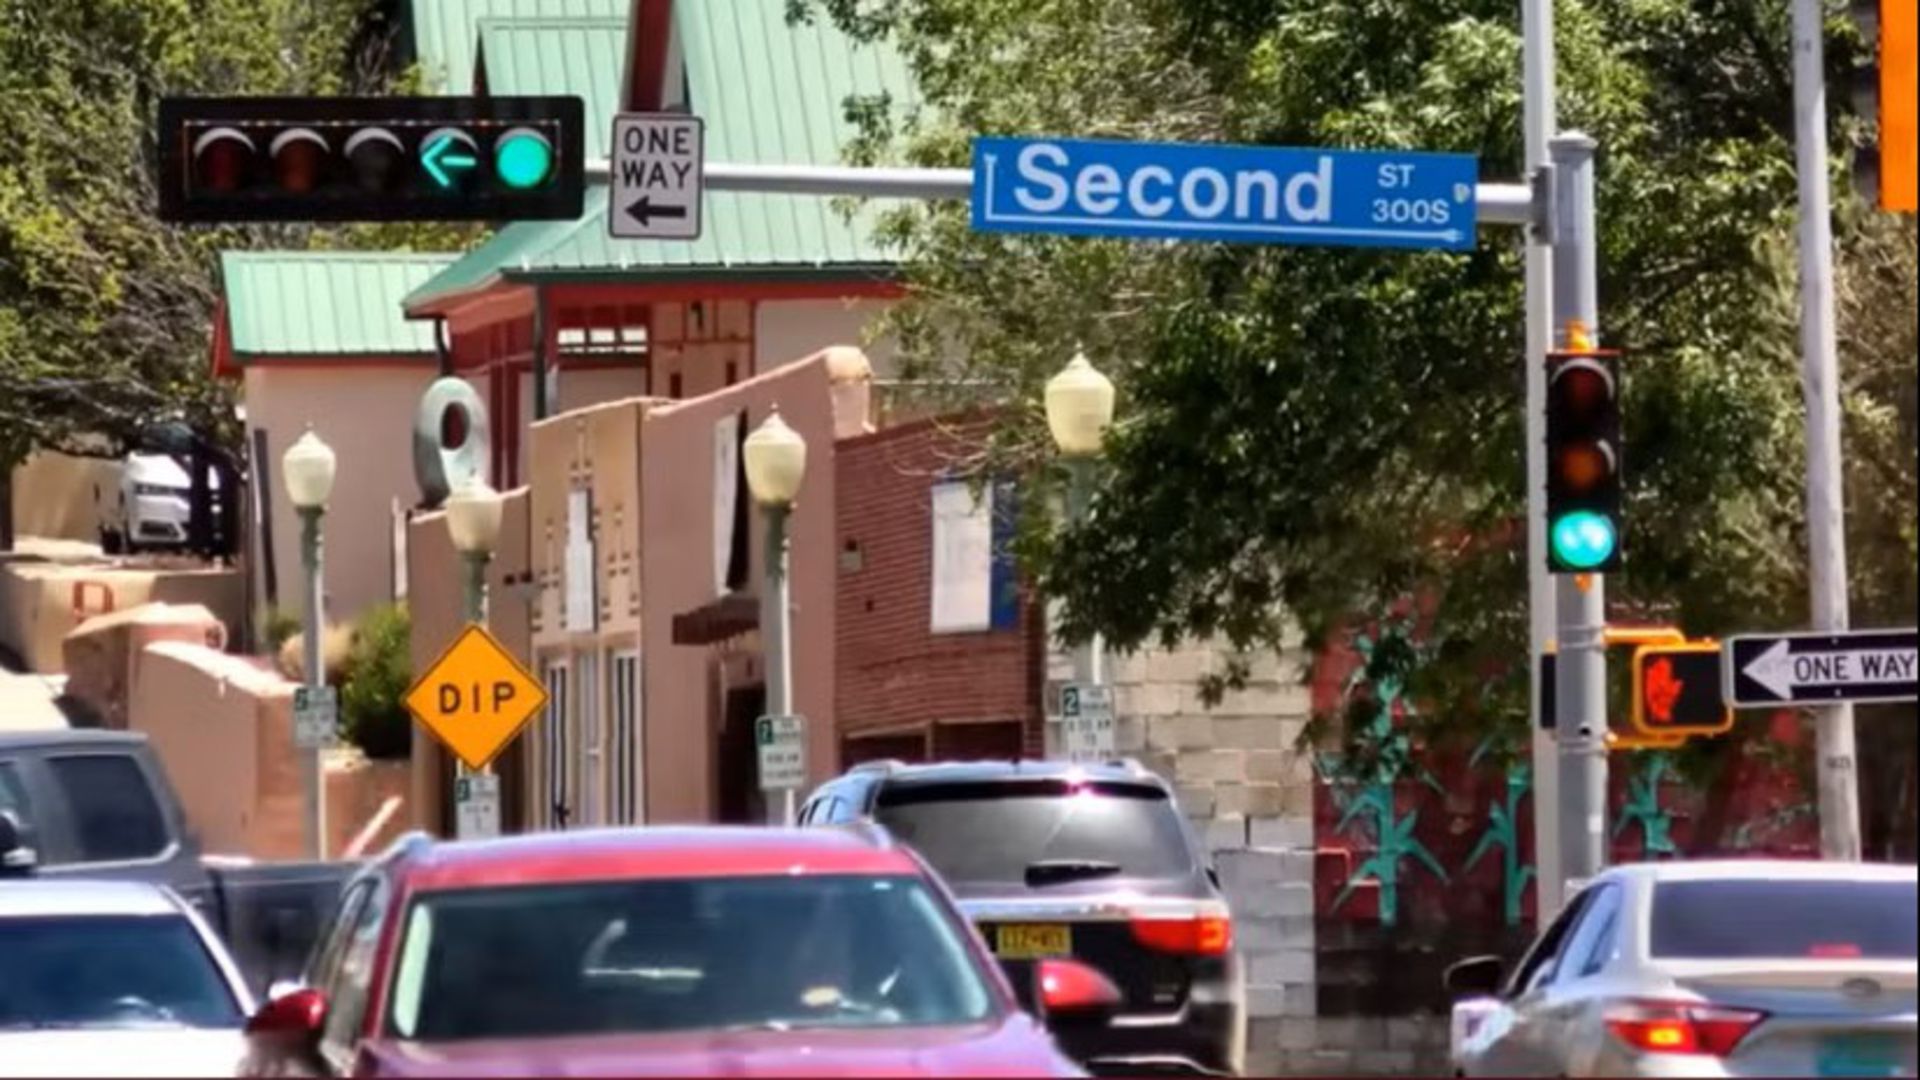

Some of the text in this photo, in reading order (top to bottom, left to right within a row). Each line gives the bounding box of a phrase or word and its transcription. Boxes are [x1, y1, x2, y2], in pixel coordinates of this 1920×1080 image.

[624, 126, 692, 155] ONE
[621, 159, 692, 189] WAY
[1014, 143, 1333, 222] Second
[1377, 163, 1416, 189] ST
[1371, 198, 1450, 224] 300S
[1793, 653, 1916, 682] ONE WAY
[438, 682, 516, 714] DIP
[1064, 690, 1077, 714] 2
